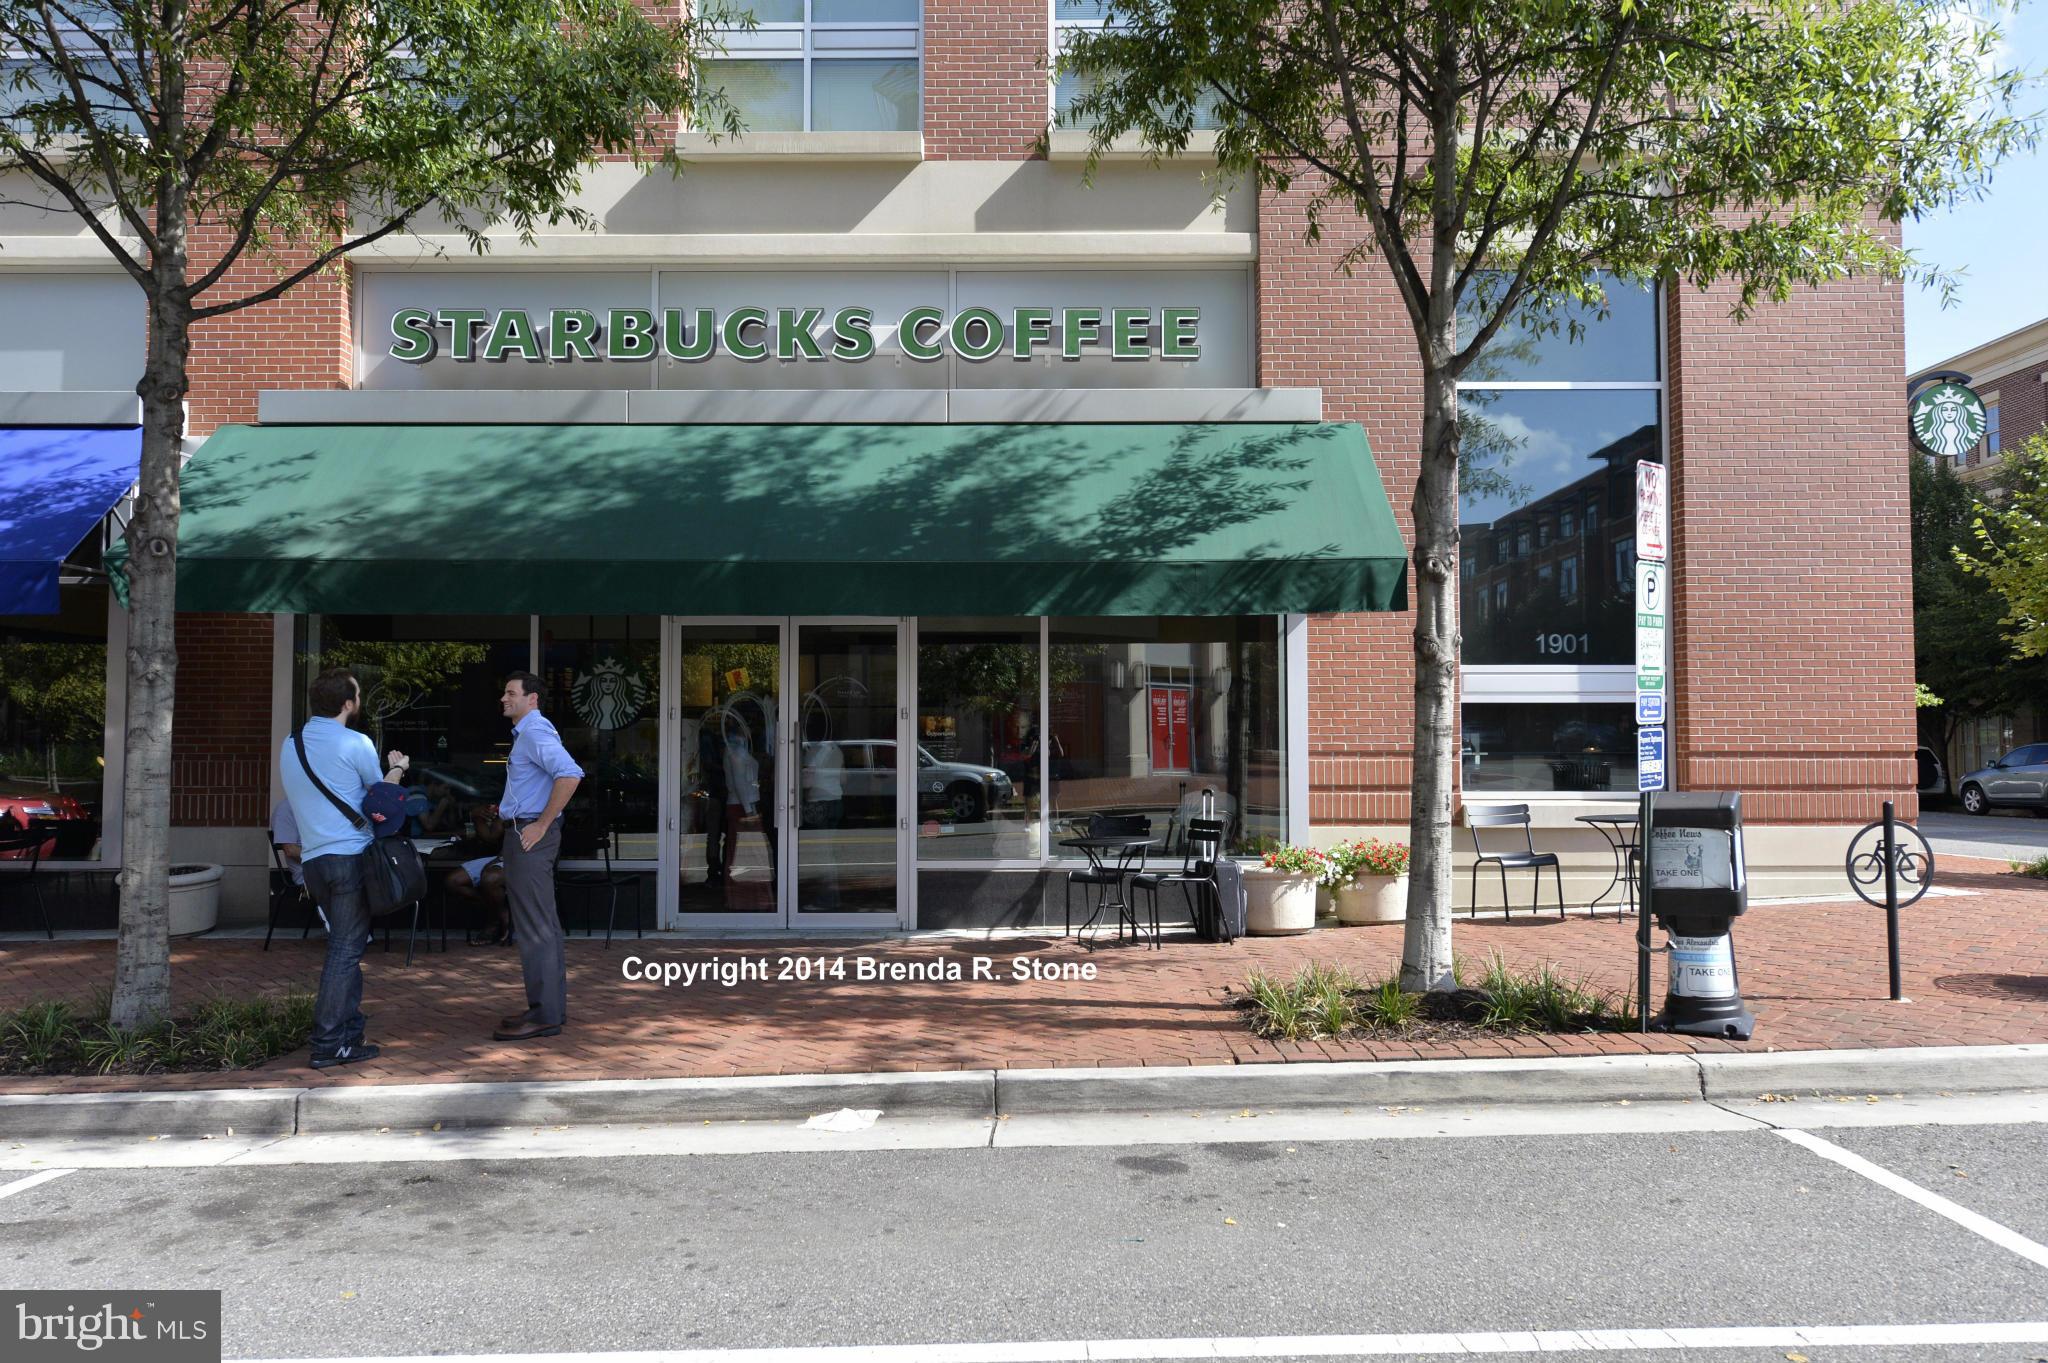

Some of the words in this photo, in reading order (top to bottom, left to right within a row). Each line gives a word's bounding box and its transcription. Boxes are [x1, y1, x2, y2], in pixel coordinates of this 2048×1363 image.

[388, 307, 876, 361] STARBUCKS
[898, 306, 1201, 361] COFFEE
[1644, 471, 1657, 489] NO
[1647, 577, 1656, 605] P
[1638, 615, 1646, 626] PAY
[1647, 616, 1652, 627] TO
[1653, 616, 1663, 628] PARK
[1535, 633, 1589, 654] 1901
[1640, 697, 1648, 707] PAY
[1680, 829, 1702, 838] News
[1656, 869, 1678, 877] TAKE
[1689, 968, 1716, 977] TAKE
[1717, 968, 1731, 976] ONE
